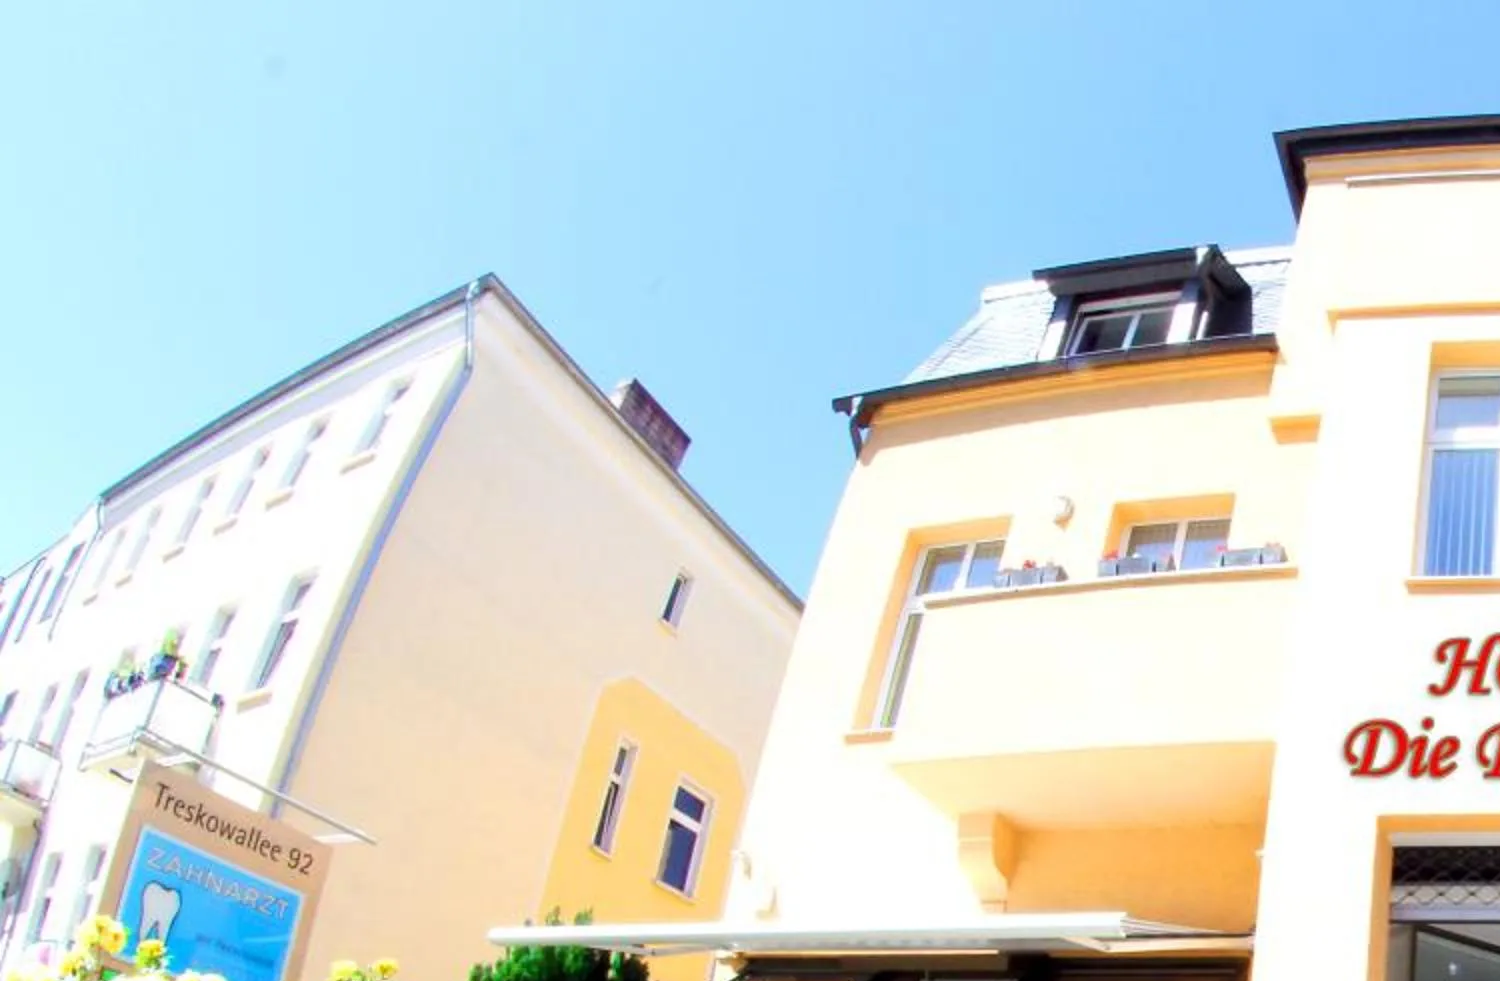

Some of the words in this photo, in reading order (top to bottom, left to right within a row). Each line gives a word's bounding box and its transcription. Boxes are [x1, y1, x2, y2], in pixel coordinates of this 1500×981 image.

[1343, 717, 1461, 779] Die
[154, 781, 283, 863] Treskowallee
[286, 847, 314, 876] 92
[147, 847, 290, 921] ZAHNARZT
